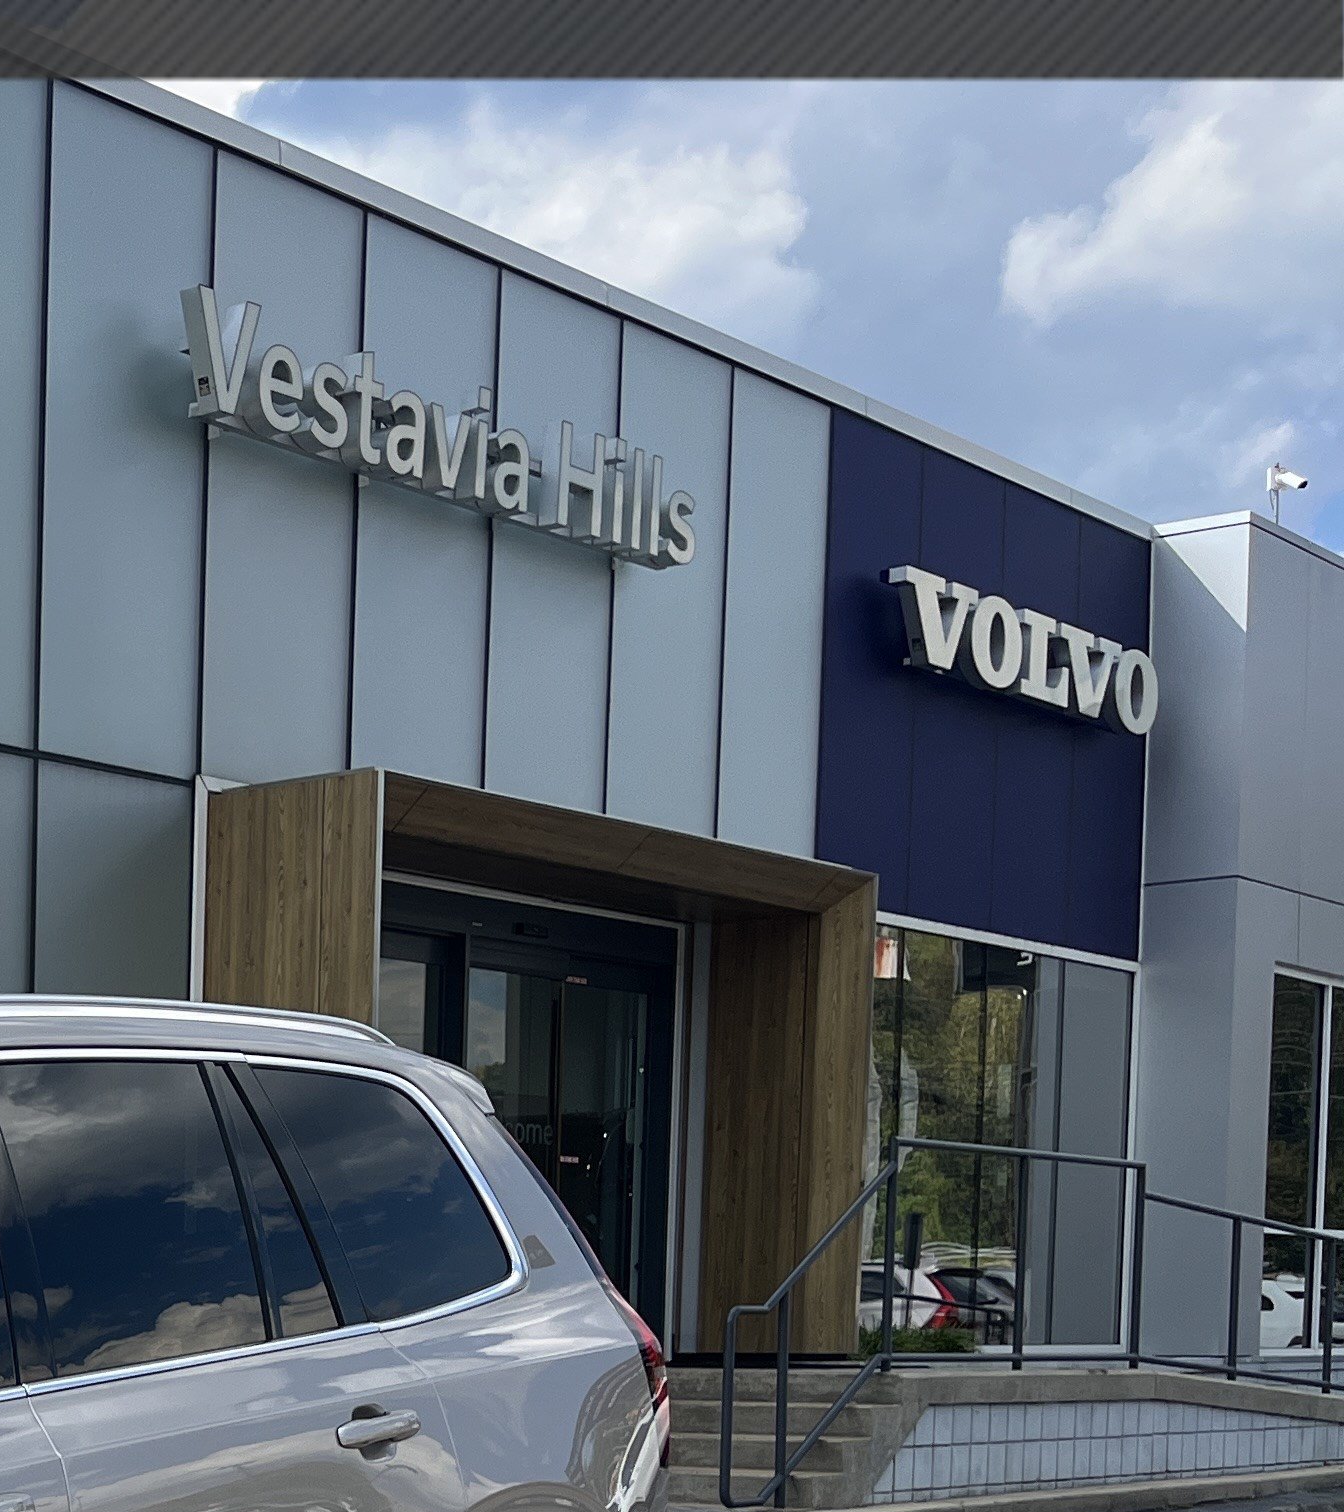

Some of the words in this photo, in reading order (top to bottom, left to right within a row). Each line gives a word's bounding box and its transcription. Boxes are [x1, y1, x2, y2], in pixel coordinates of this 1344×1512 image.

[180, 284, 534, 520] Vestavia
[556, 420, 697, 566] Hills
[889, 565, 1159, 735] VOLVO
